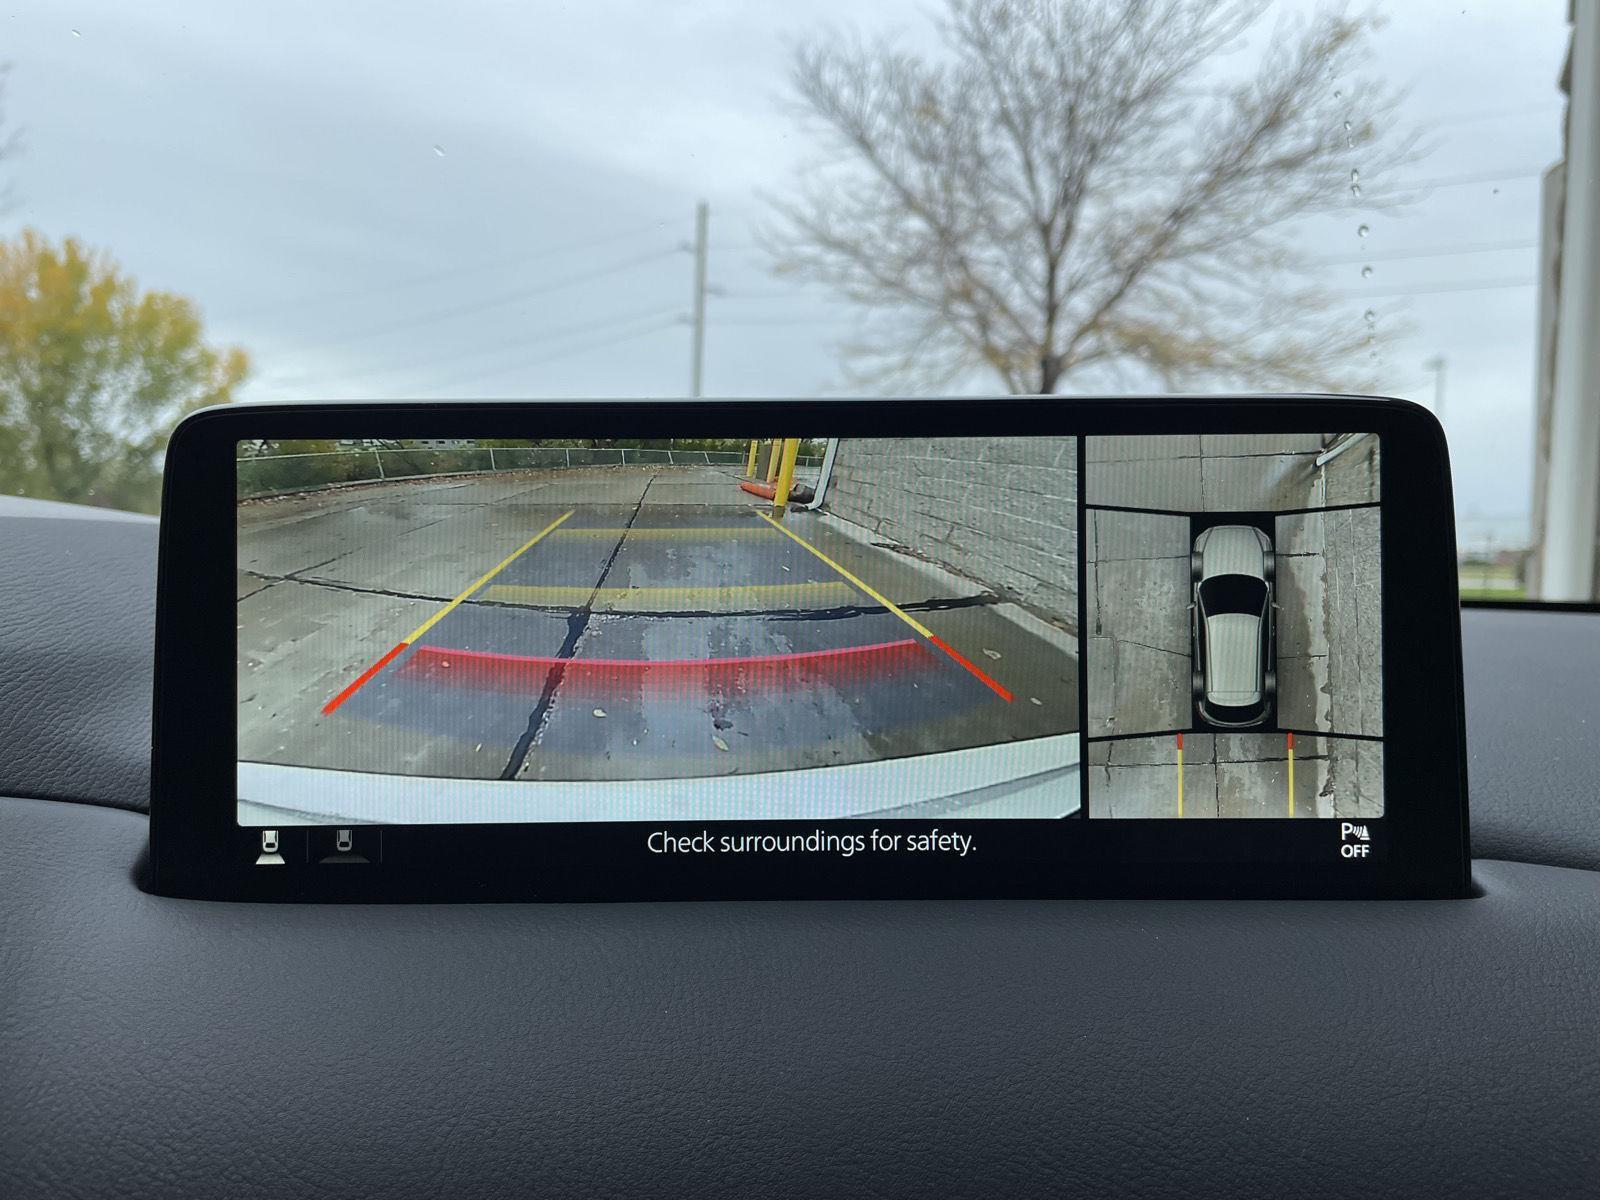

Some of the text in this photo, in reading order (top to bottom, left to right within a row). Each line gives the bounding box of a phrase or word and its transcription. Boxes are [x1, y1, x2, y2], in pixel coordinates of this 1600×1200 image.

[1341, 822, 1354, 841] P
[647, 828, 977, 857] Check surroundings for safety.
[1340, 843, 1370, 858] OFF
